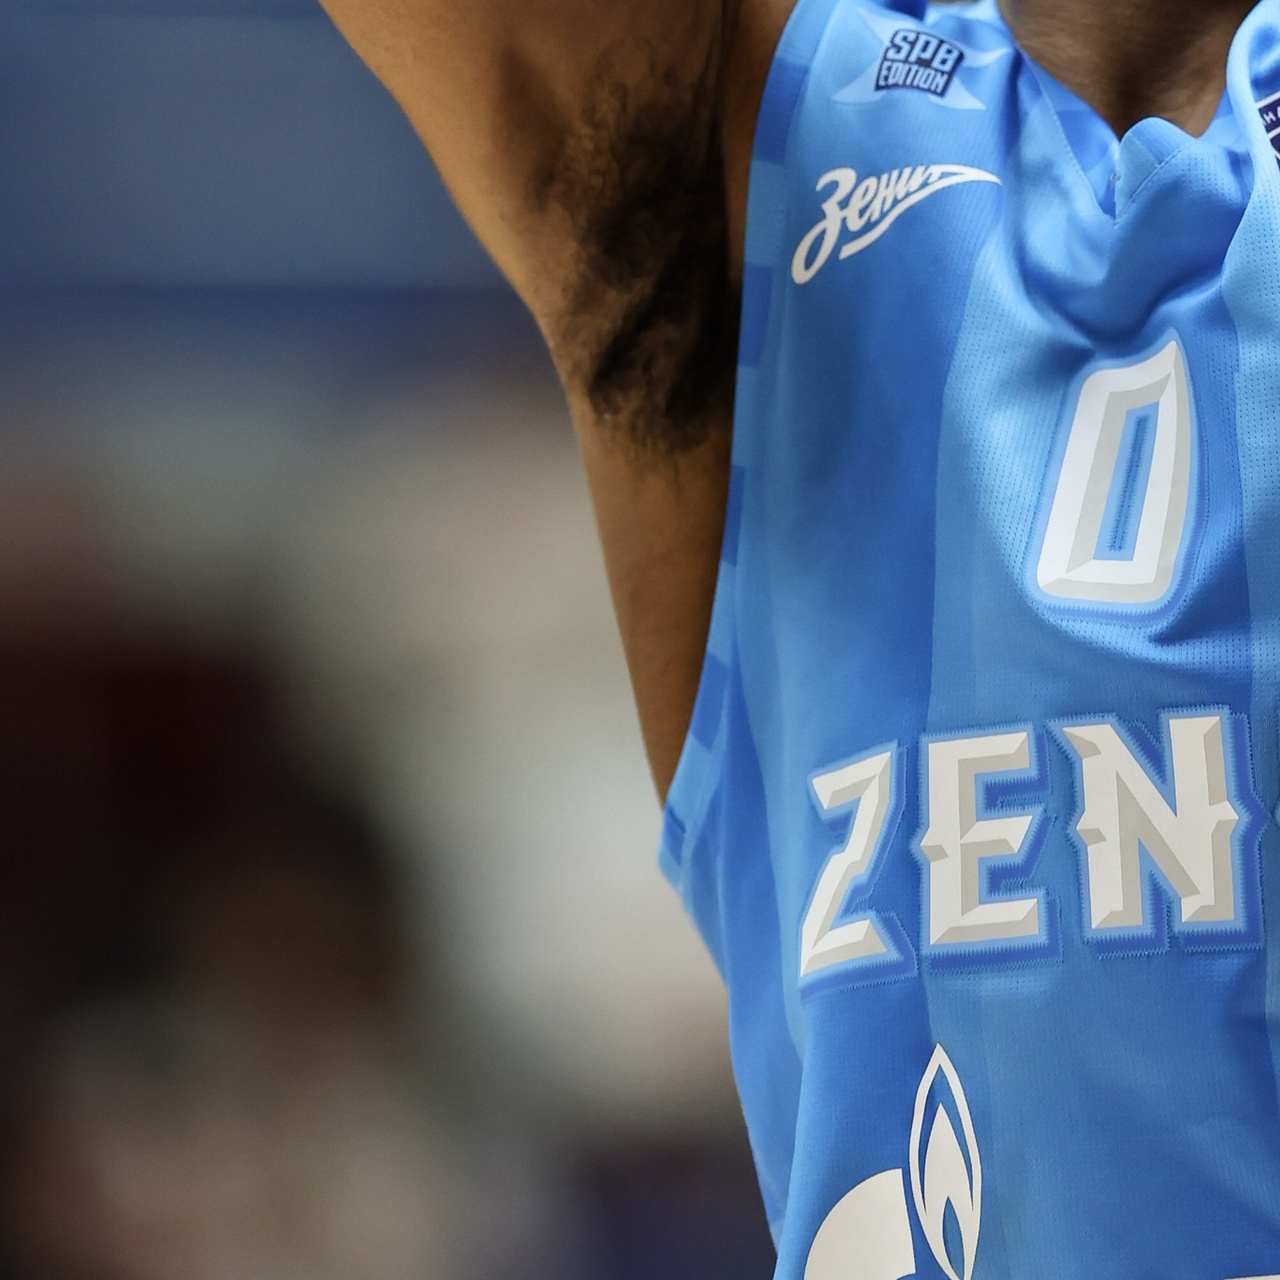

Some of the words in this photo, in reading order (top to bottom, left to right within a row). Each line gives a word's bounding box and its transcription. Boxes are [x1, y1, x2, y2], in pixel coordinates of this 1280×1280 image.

[886, 30, 962, 72] SPB
[877, 60, 950, 95] EDITION
[1036, 340, 1192, 604] 0
